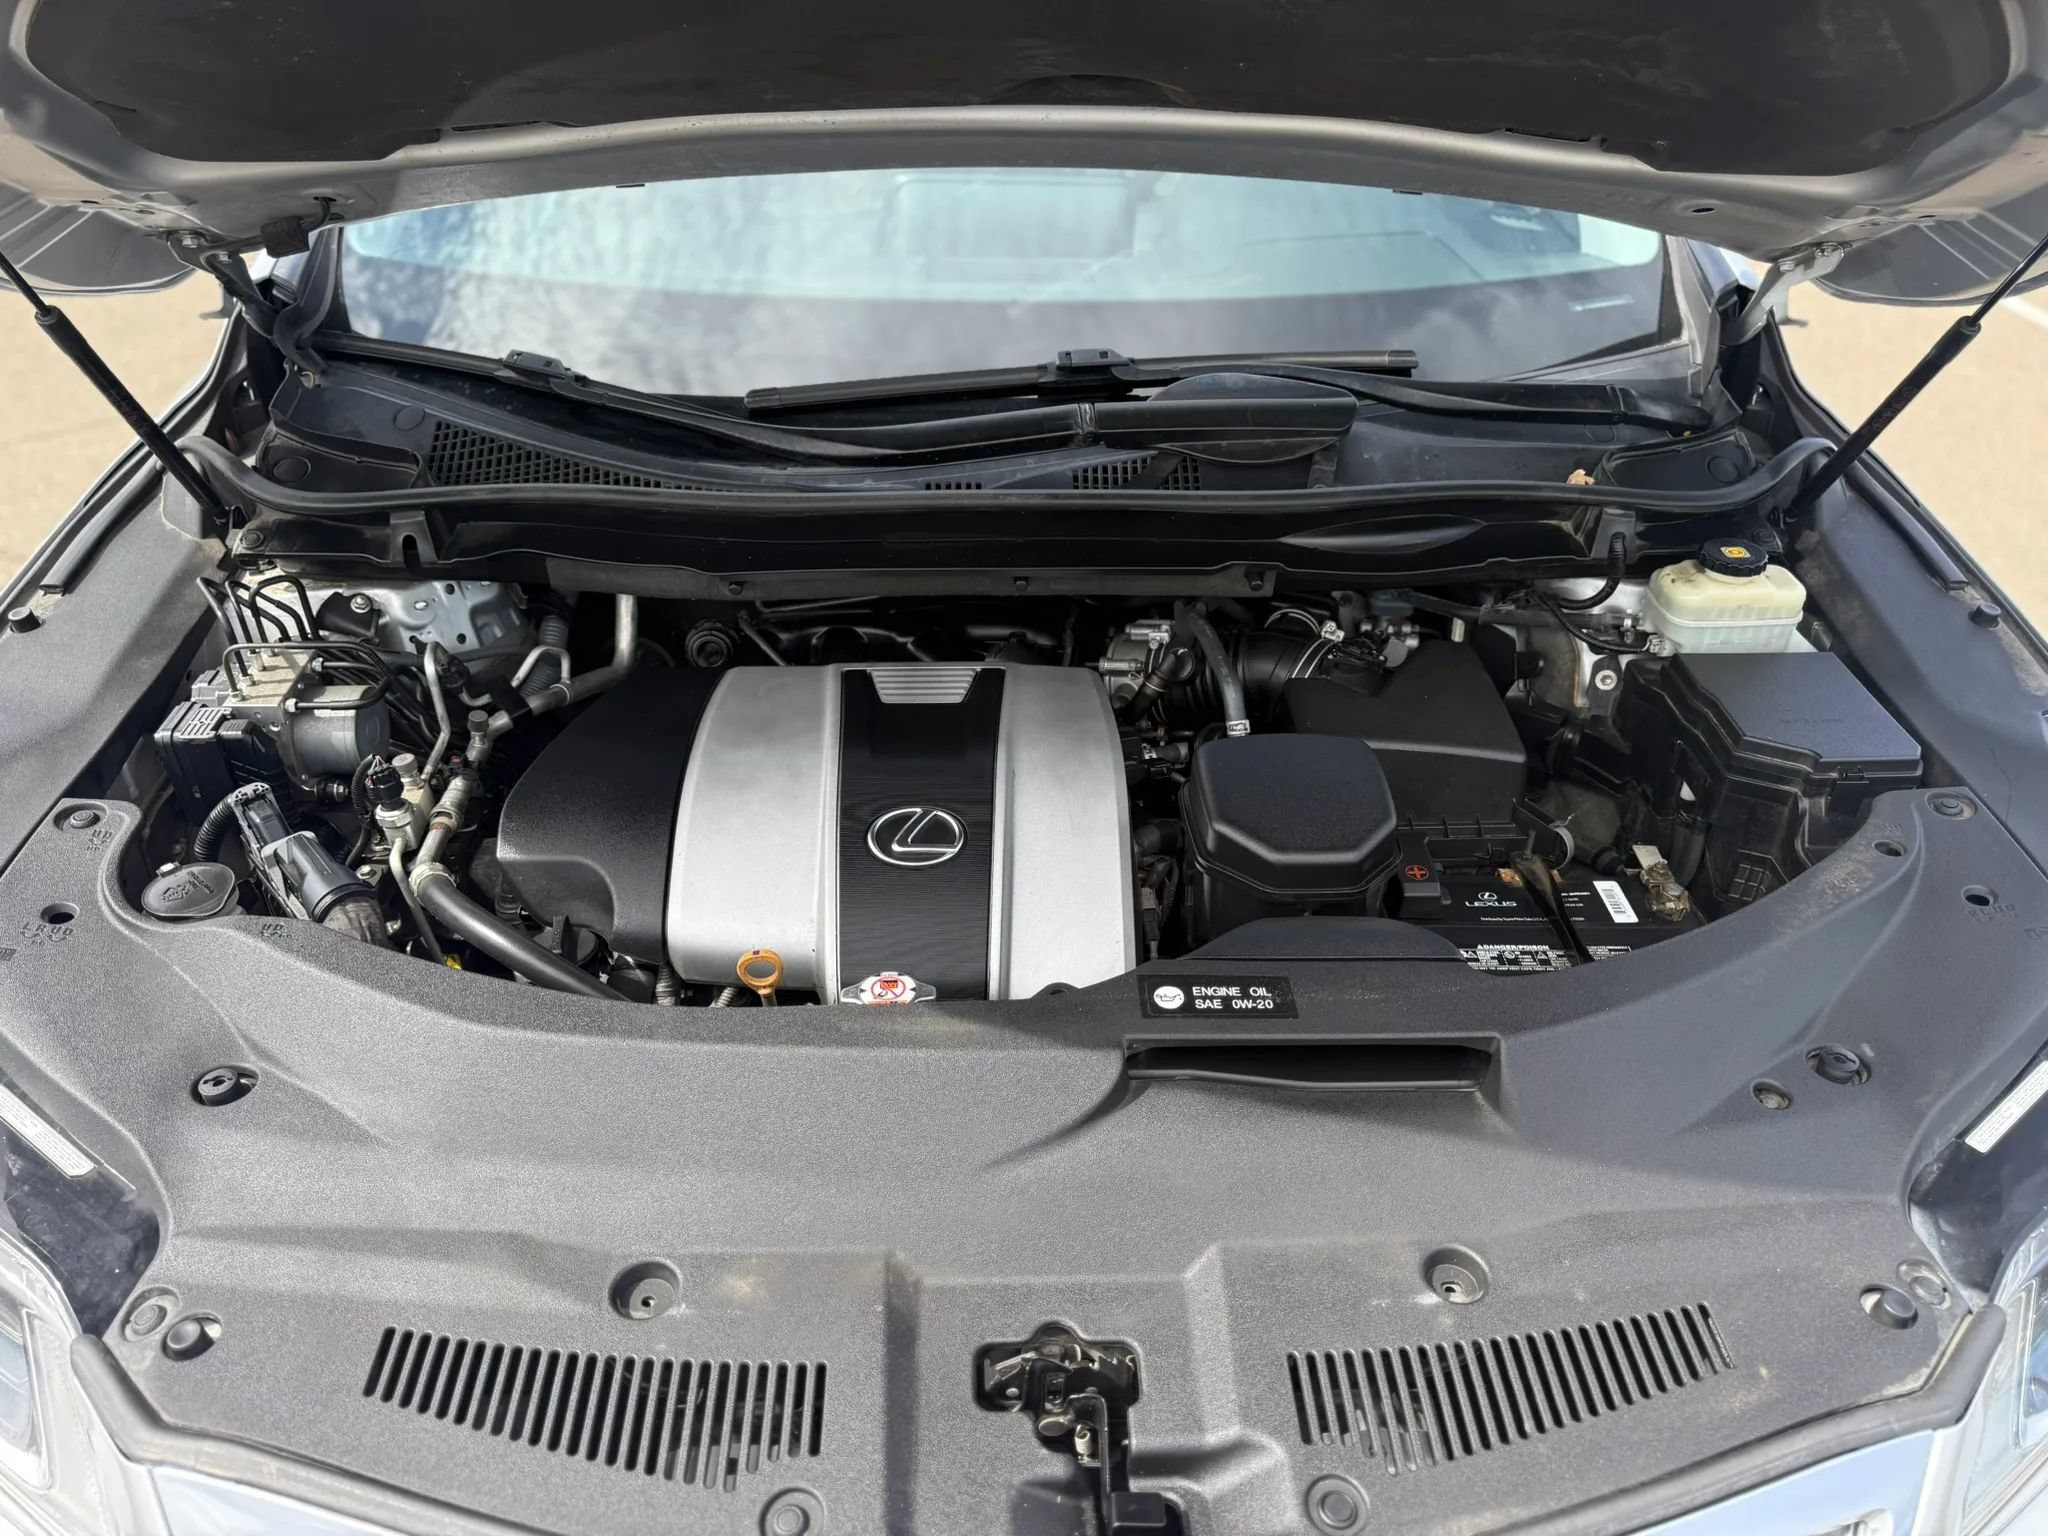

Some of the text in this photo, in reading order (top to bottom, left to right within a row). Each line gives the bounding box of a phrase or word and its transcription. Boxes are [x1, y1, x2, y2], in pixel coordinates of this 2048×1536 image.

[1192, 986, 1272, 997] ENGINE OIL
[1195, 999, 1273, 1009] SAE 0W-20
